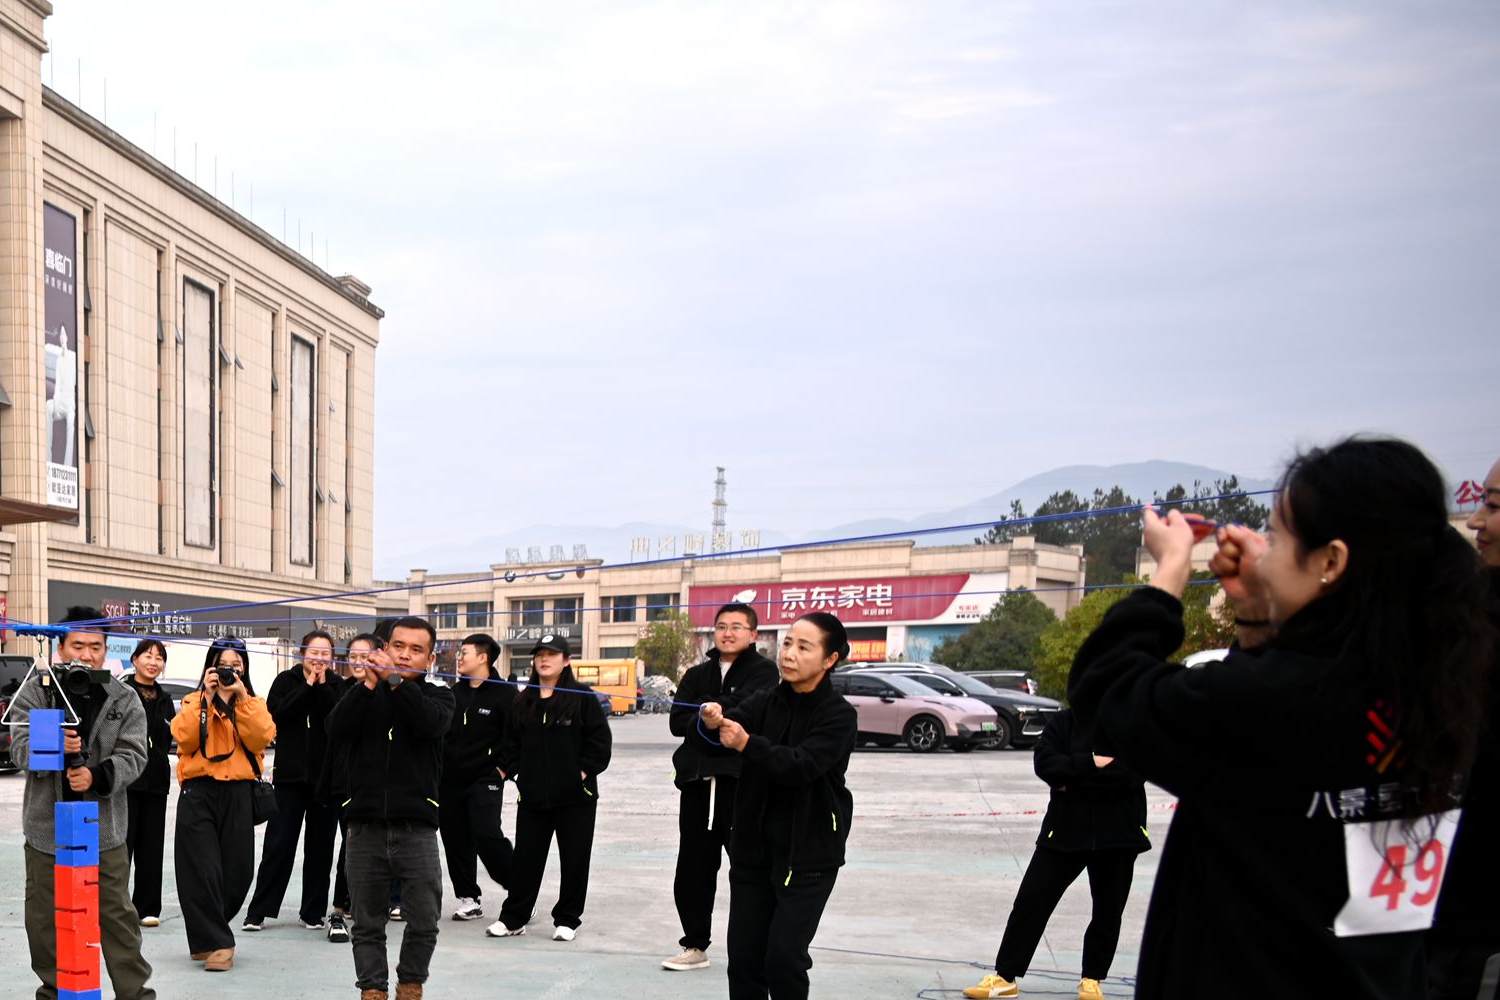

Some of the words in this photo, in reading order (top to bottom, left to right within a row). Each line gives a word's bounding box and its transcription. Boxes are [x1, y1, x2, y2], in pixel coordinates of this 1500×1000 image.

[45, 247, 72, 278] 喜临门
[781, 583, 893, 611] 京东家电
[1368, 838, 1445, 911] 49
